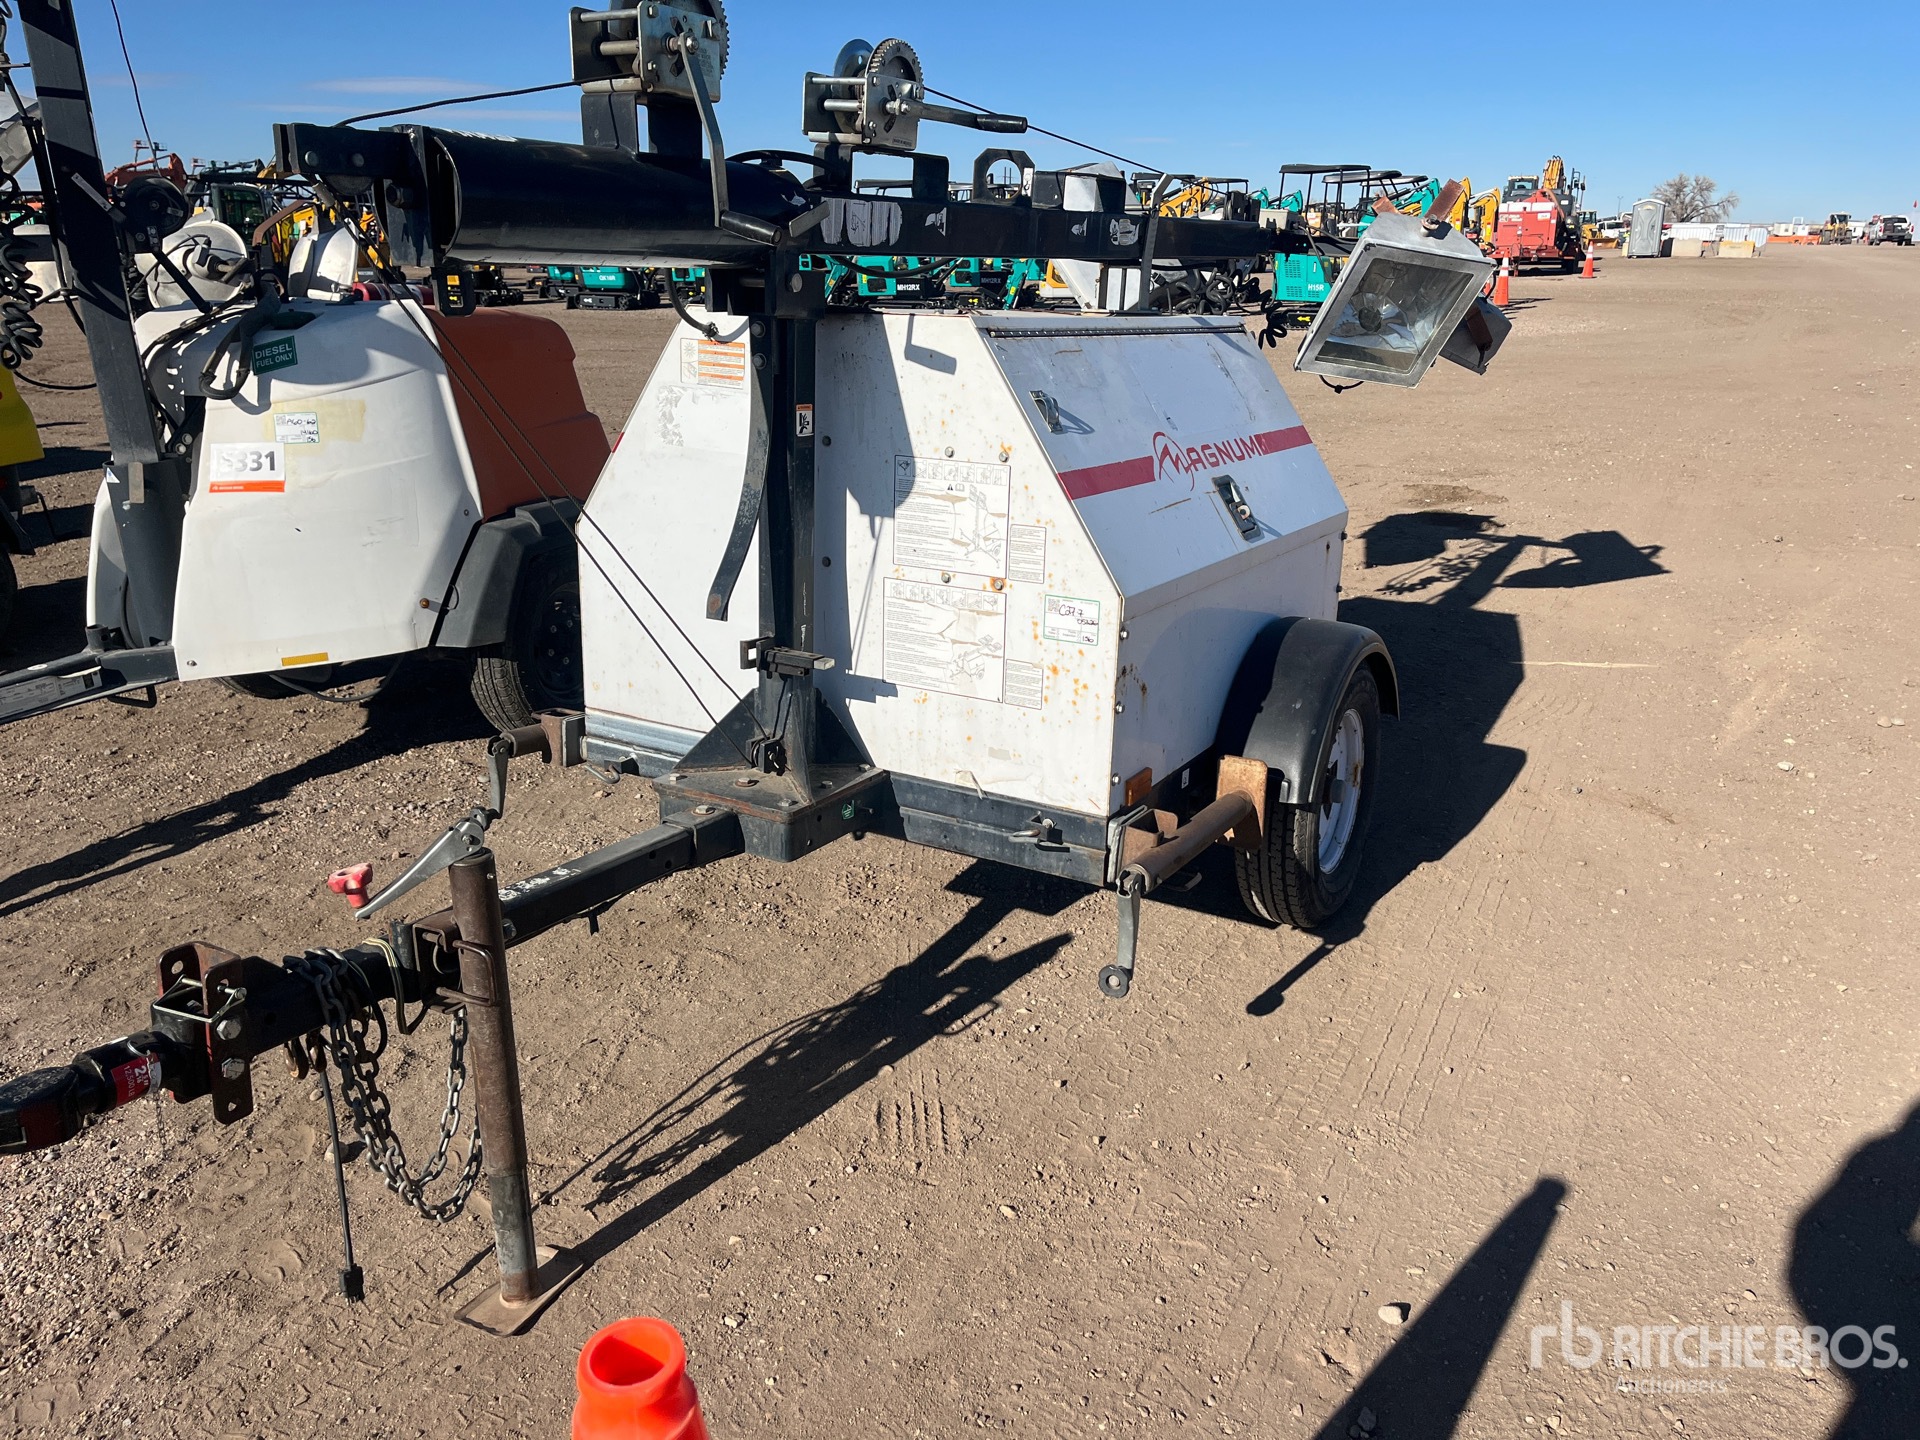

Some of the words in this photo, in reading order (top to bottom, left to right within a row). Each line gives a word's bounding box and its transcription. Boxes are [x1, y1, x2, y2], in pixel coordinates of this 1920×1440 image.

[255, 344, 292, 359] DIESEL
[256, 358, 274, 368] FUEL
[275, 352, 292, 363] ONLY
[1154, 433, 1262, 483] MAGNUM
